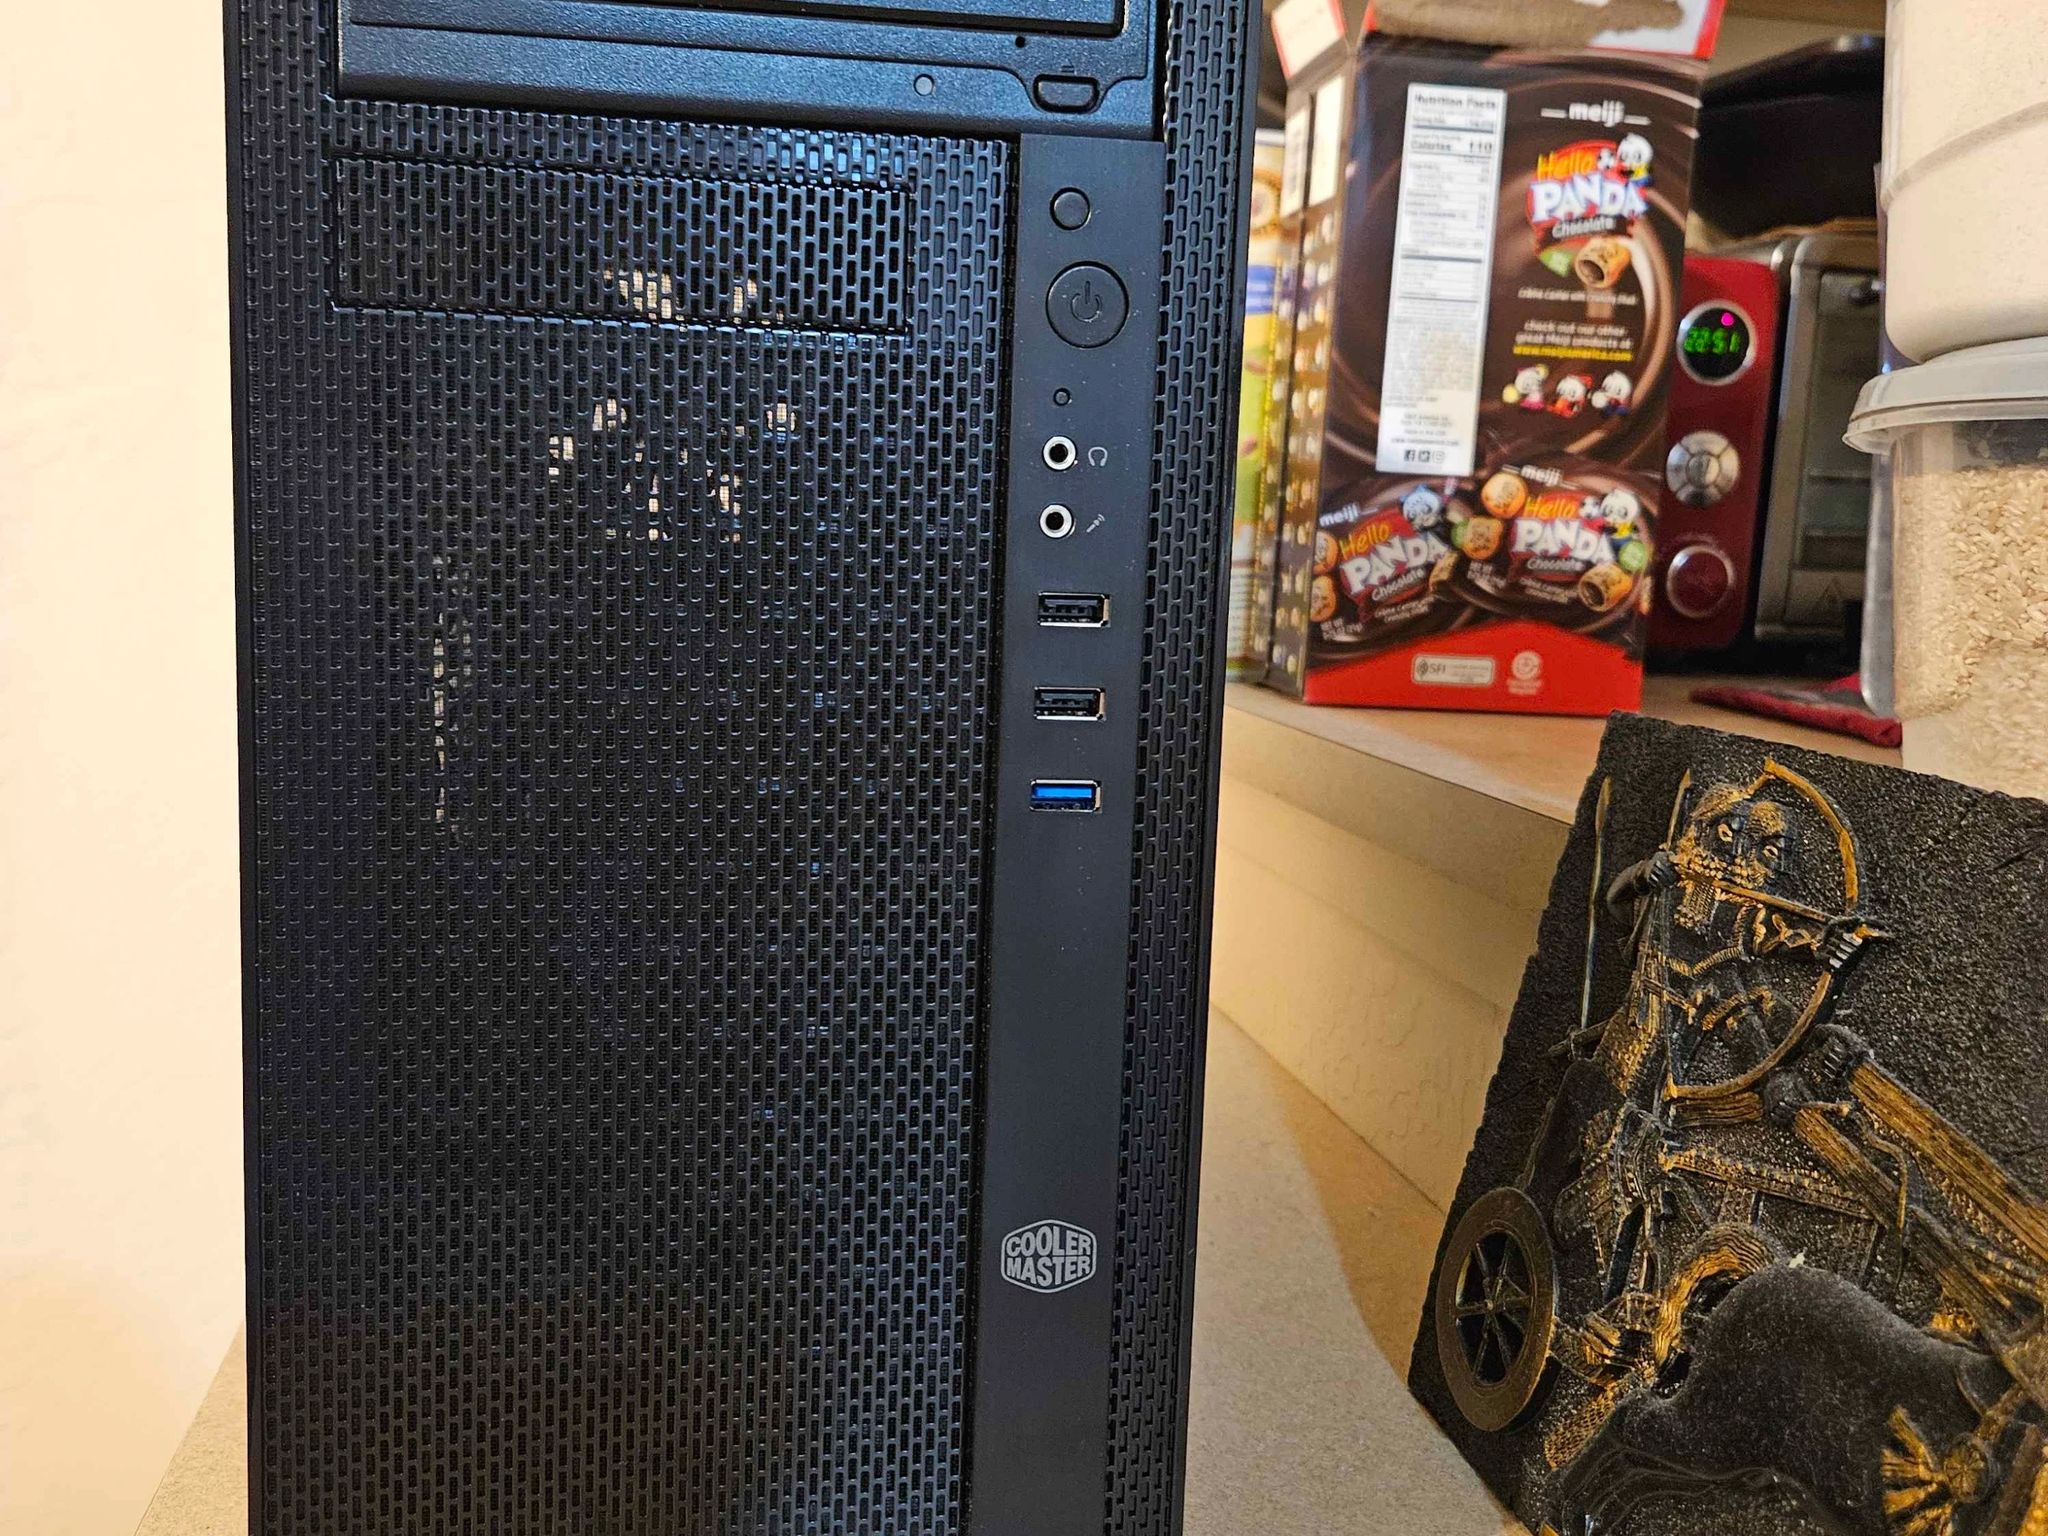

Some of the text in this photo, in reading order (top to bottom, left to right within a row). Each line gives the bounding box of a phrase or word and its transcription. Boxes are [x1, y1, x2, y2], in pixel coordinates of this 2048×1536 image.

[1568, 99, 1625, 127] meiji
[1537, 149, 1597, 182] Hello
[1530, 170, 1649, 223] PANDA
[1552, 216, 1617, 239] Chocolate
[1521, 464, 1563, 488] meiji
[1319, 502, 1360, 527] meiji
[1522, 495, 1578, 521] Hello
[1338, 521, 1391, 561] Hello
[1514, 517, 1617, 566] PANDA
[1340, 531, 1449, 595] PANDA
[1527, 555, 1585, 573] Chocolate
[1372, 566, 1425, 601] Chocolate
[1006, 1225, 1092, 1257] COOLER
[1006, 1256, 1091, 1287] MASTER
